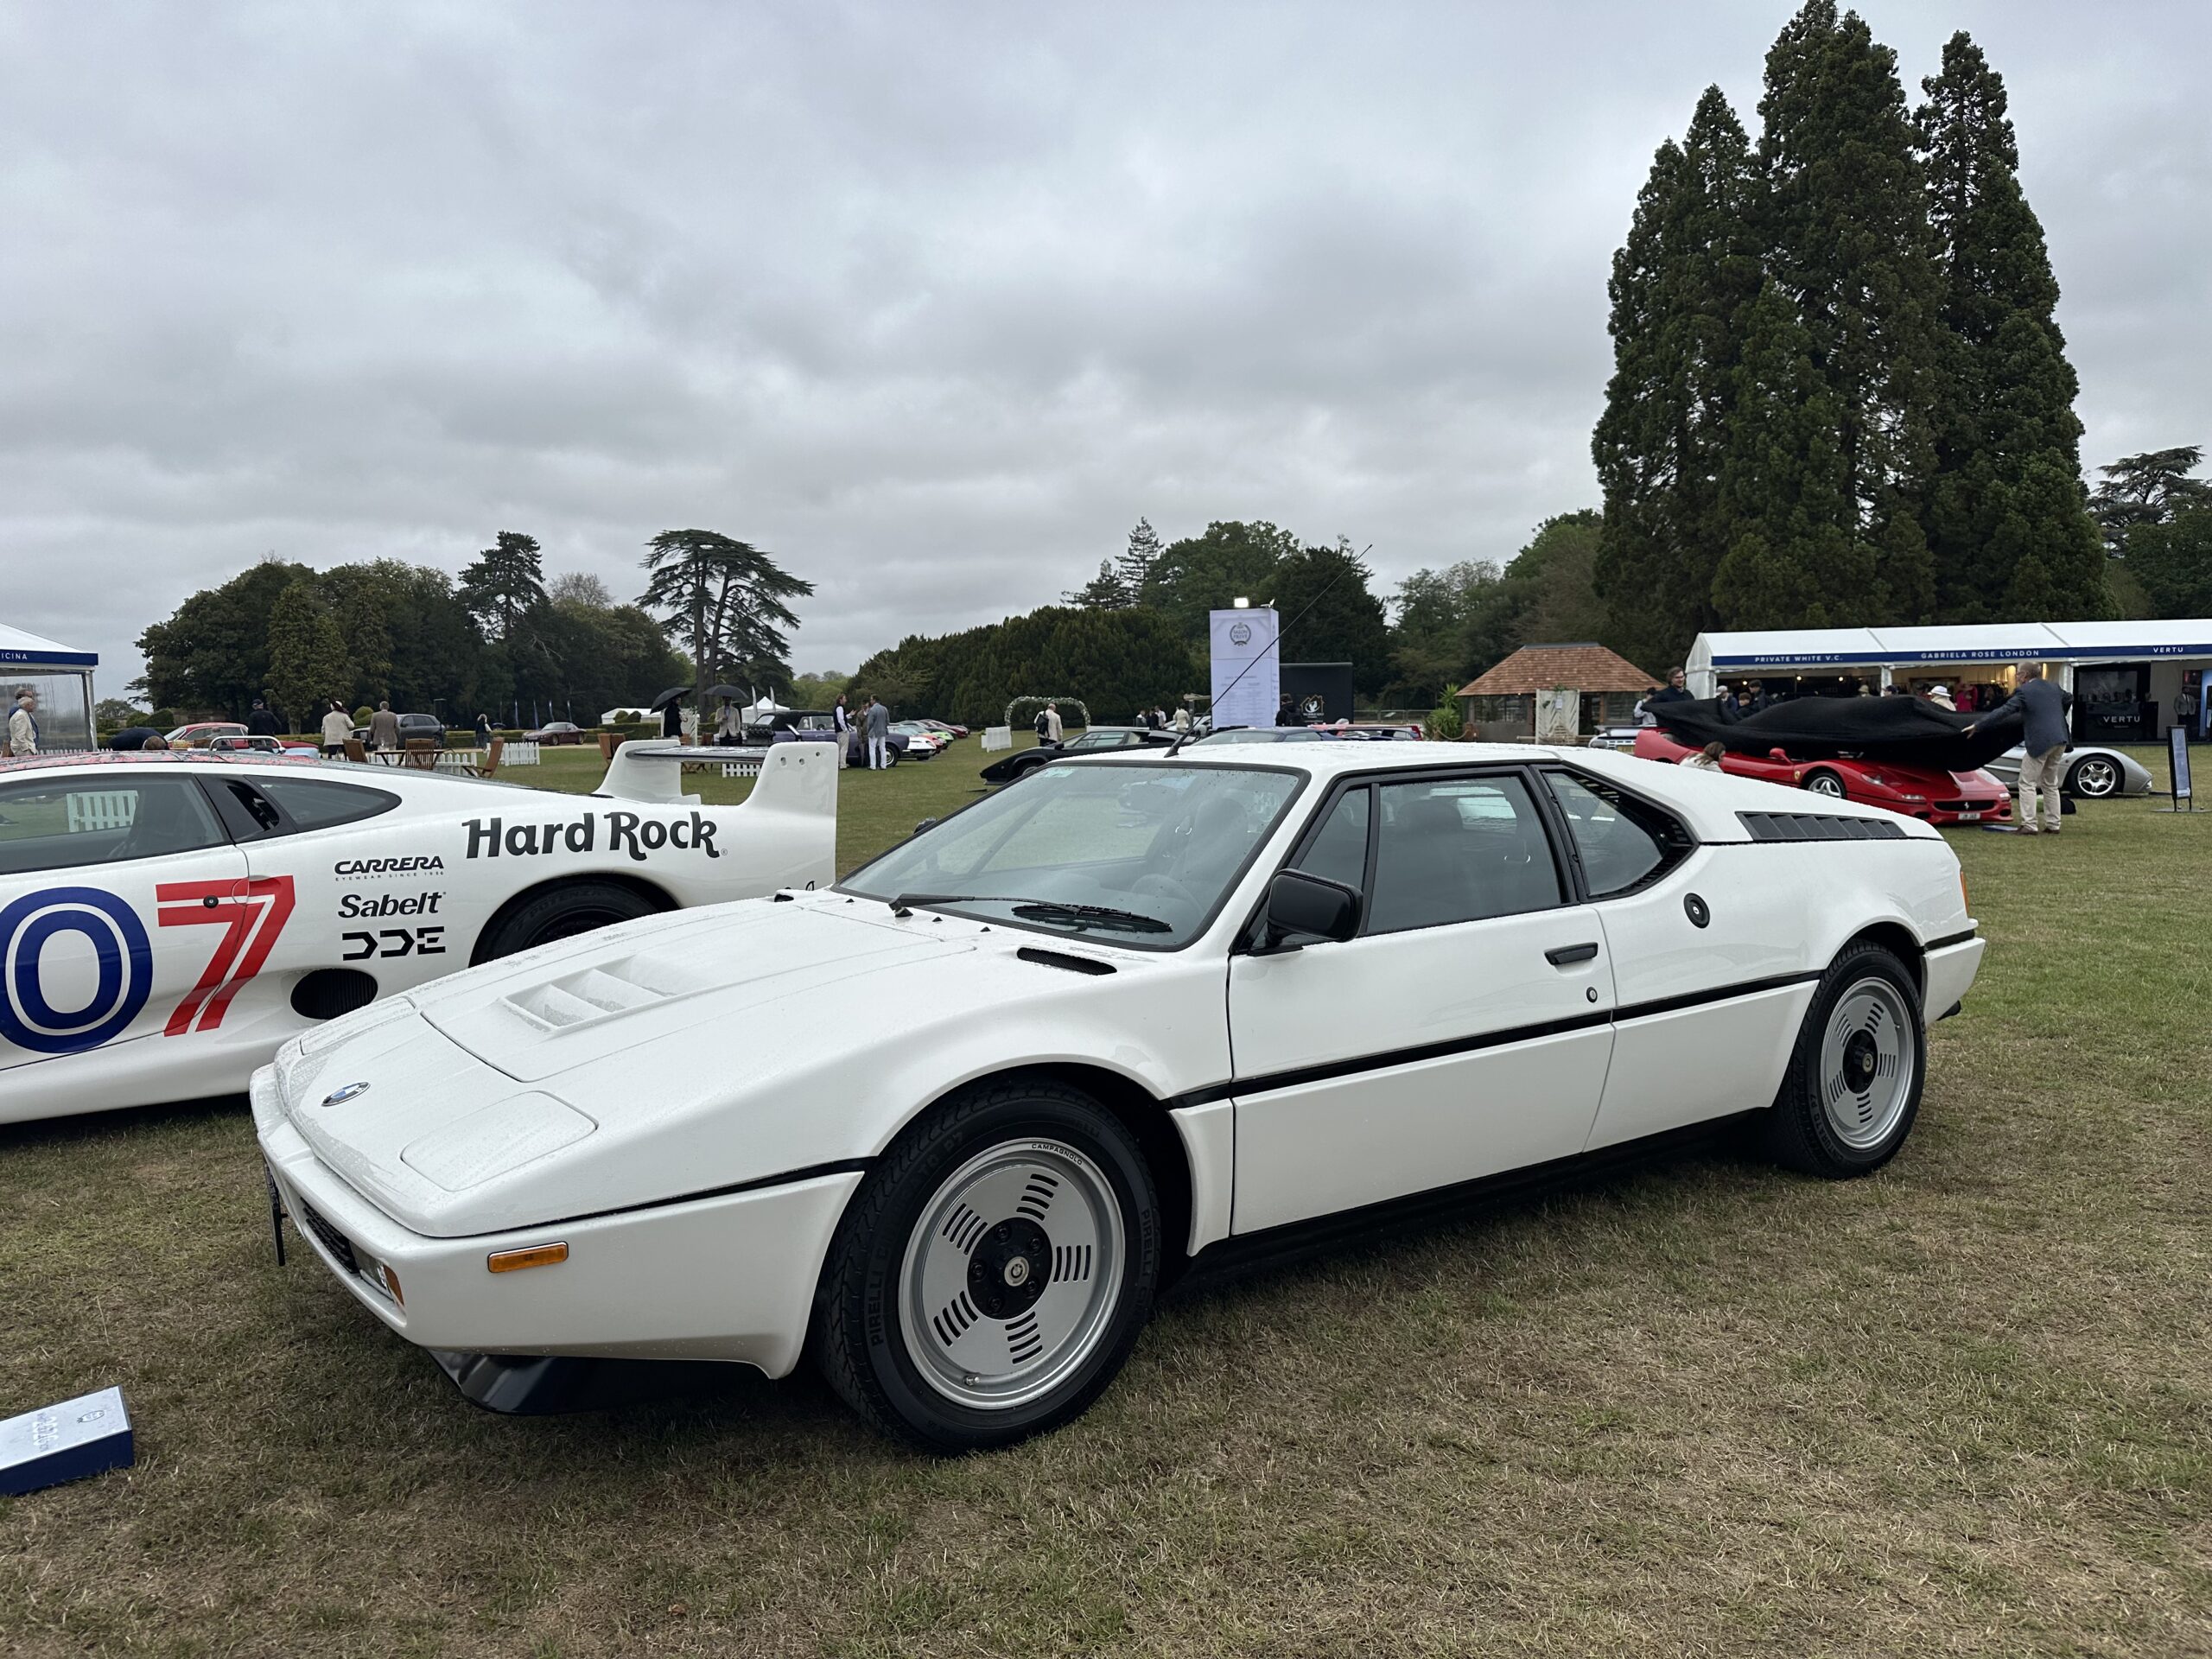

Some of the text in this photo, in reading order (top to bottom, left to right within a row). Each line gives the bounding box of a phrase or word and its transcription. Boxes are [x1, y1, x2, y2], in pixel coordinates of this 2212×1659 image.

[461, 810, 721, 861] Hard Rock
[334, 855, 444, 875] CARRERA
[338, 891, 442, 918] Sabelt
[342, 926, 446, 961] DDE
[1031, 1143, 1083, 1166] CAMPAGNOLO
[1140, 1208, 1154, 1276] PIRELLI
[868, 1270, 885, 1347] PIRELLI
